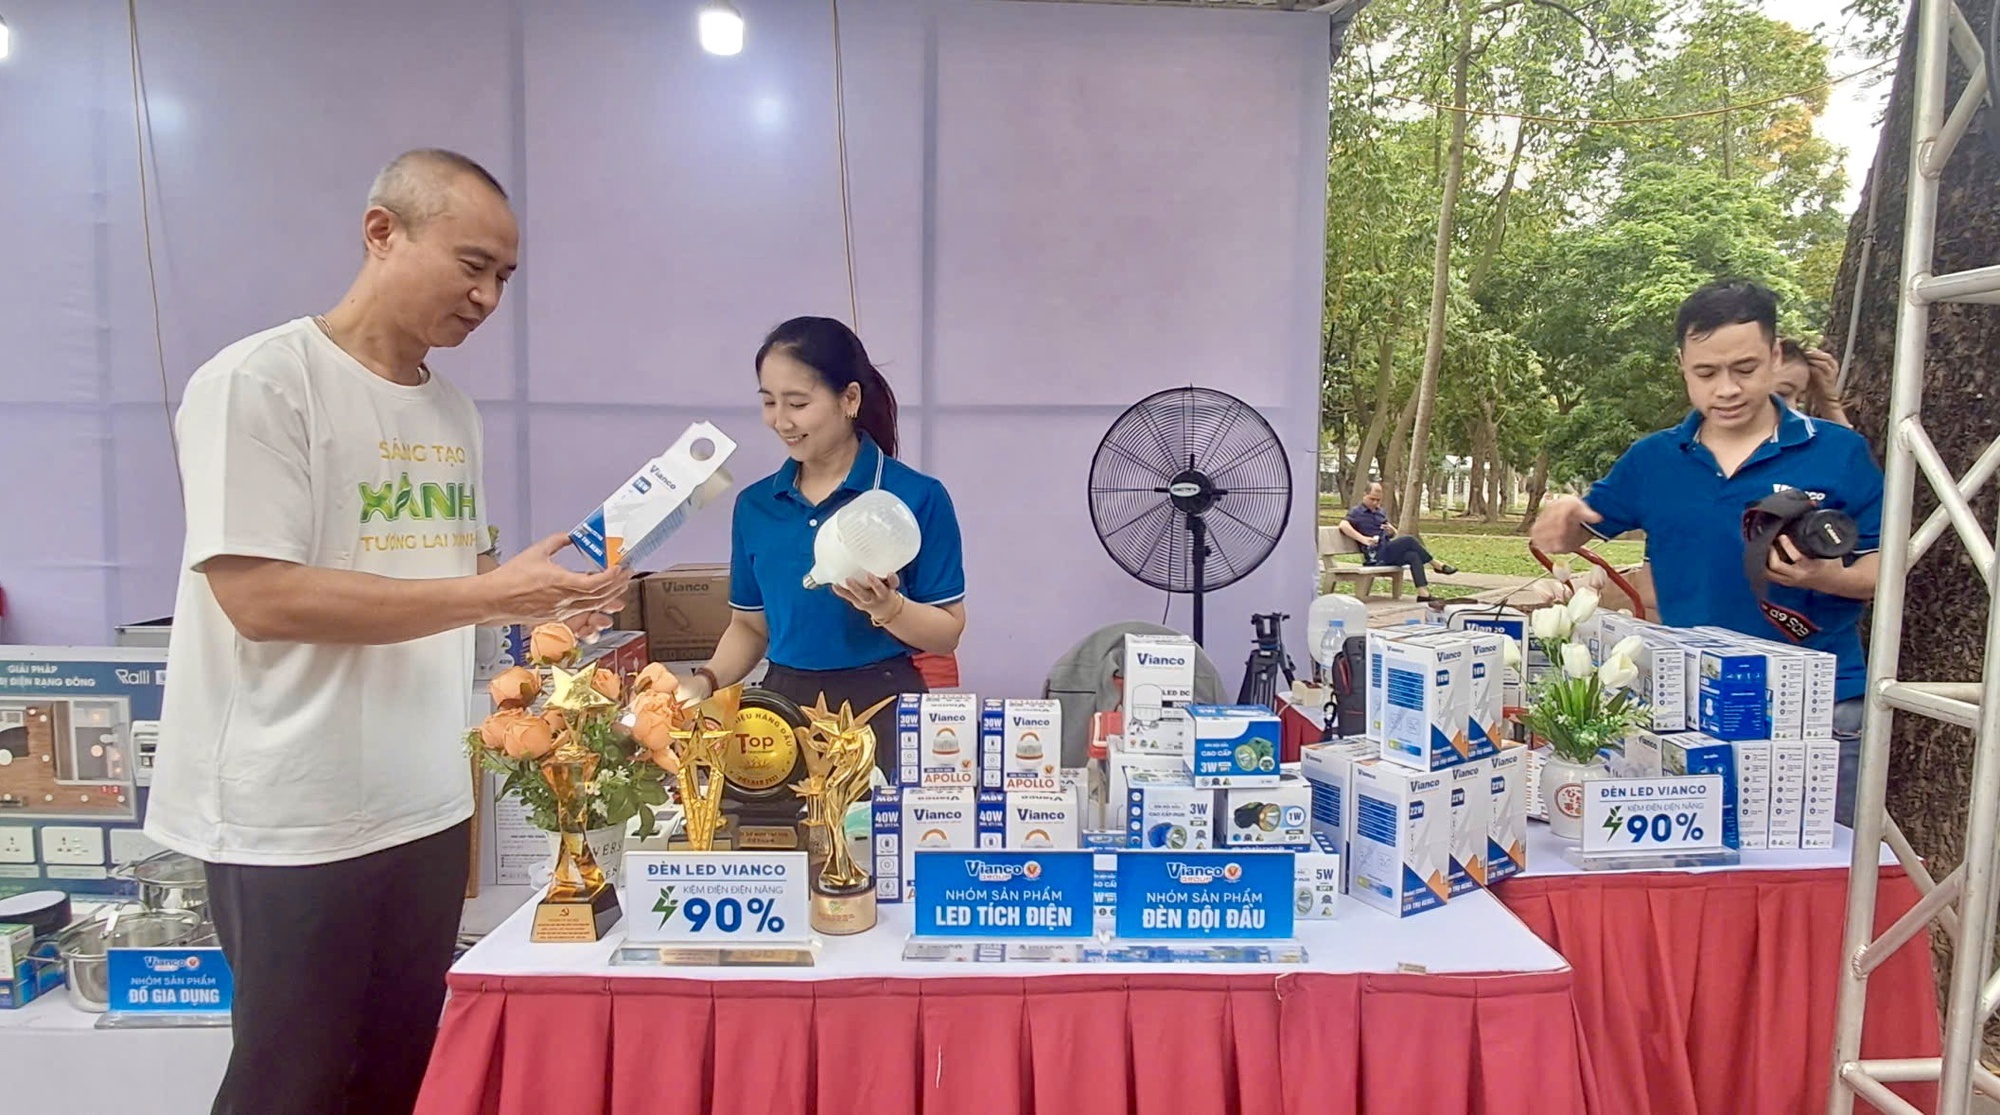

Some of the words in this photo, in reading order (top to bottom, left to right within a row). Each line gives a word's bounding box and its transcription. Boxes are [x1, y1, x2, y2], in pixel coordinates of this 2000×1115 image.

[432, 445, 466, 467] TẠO
[649, 465, 676, 490] Vianco
[423, 533, 447, 549] LAI
[662, 582, 709, 593] Vianco
[1769, 608, 1788, 622] 6D
[1785, 617, 1810, 637] EOS
[1436, 650, 1462, 662] Vianco
[1472, 644, 1497, 655] Vianco
[1136, 652, 1186, 665] Vianco
[900, 714, 919, 724] 30W
[929, 713, 966, 723] Vianco
[984, 718, 1003, 728] 30W
[1013, 716, 1050, 727] Vianco
[1200, 761, 1217, 773] 3W
[1491, 755, 1518, 769] Vianco
[924, 773, 971, 783] APOLLO
[1452, 767, 1479, 780] Vianco
[1007, 779, 1054, 788] APOLLO
[1410, 779, 1440, 792] Vianco
[1601, 785, 1626, 798] ĐÈN
[1630, 787, 1654, 797] LED
[1657, 785, 1707, 796] VIANCO
[913, 809, 962, 821] Vianco
[1017, 808, 1065, 821] Vianco
[1189, 803, 1208, 815] 3W
[875, 811, 899, 823] 40W
[979, 810, 1003, 822] 40W
[1289, 812, 1302, 821] 1W
[1627, 812, 1704, 843] 90%
[647, 860, 681, 876] ĐÈN
[685, 864, 715, 876] LED
[722, 864, 786, 876] VIANCO
[965, 859, 1022, 877] Vianco
[1166, 861, 1223, 879] Vianco
[1316, 868, 1334, 880] 5W
[683, 883, 706, 896] KIỆM
[946, 887, 989, 901] NHÓM
[992, 886, 1020, 901] SẢN
[1023, 884, 1062, 901] PHẨM
[1146, 888, 1189, 903] NHÓM
[1192, 887, 1220, 903] SẢN
[1223, 886, 1263, 903] PHẨM
[683, 897, 785, 933] 90%
[935, 906, 971, 926] LED
[976, 902, 1021, 927] TÍCH
[1026, 904, 1072, 931] ĐIỆN
[1142, 903, 1184, 928] ĐÈN
[1187, 905, 1220, 933] ĐỘI
[1226, 899, 1265, 928] ĐẦU
[144, 955, 187, 968] Vianco
[131, 975, 162, 986] NHÓM
[164, 974, 185, 986] SẢN
[186, 974, 216, 986] PHẨM
[152, 988, 176, 1004] GIA
[179, 988, 220, 1006] DỤNG
